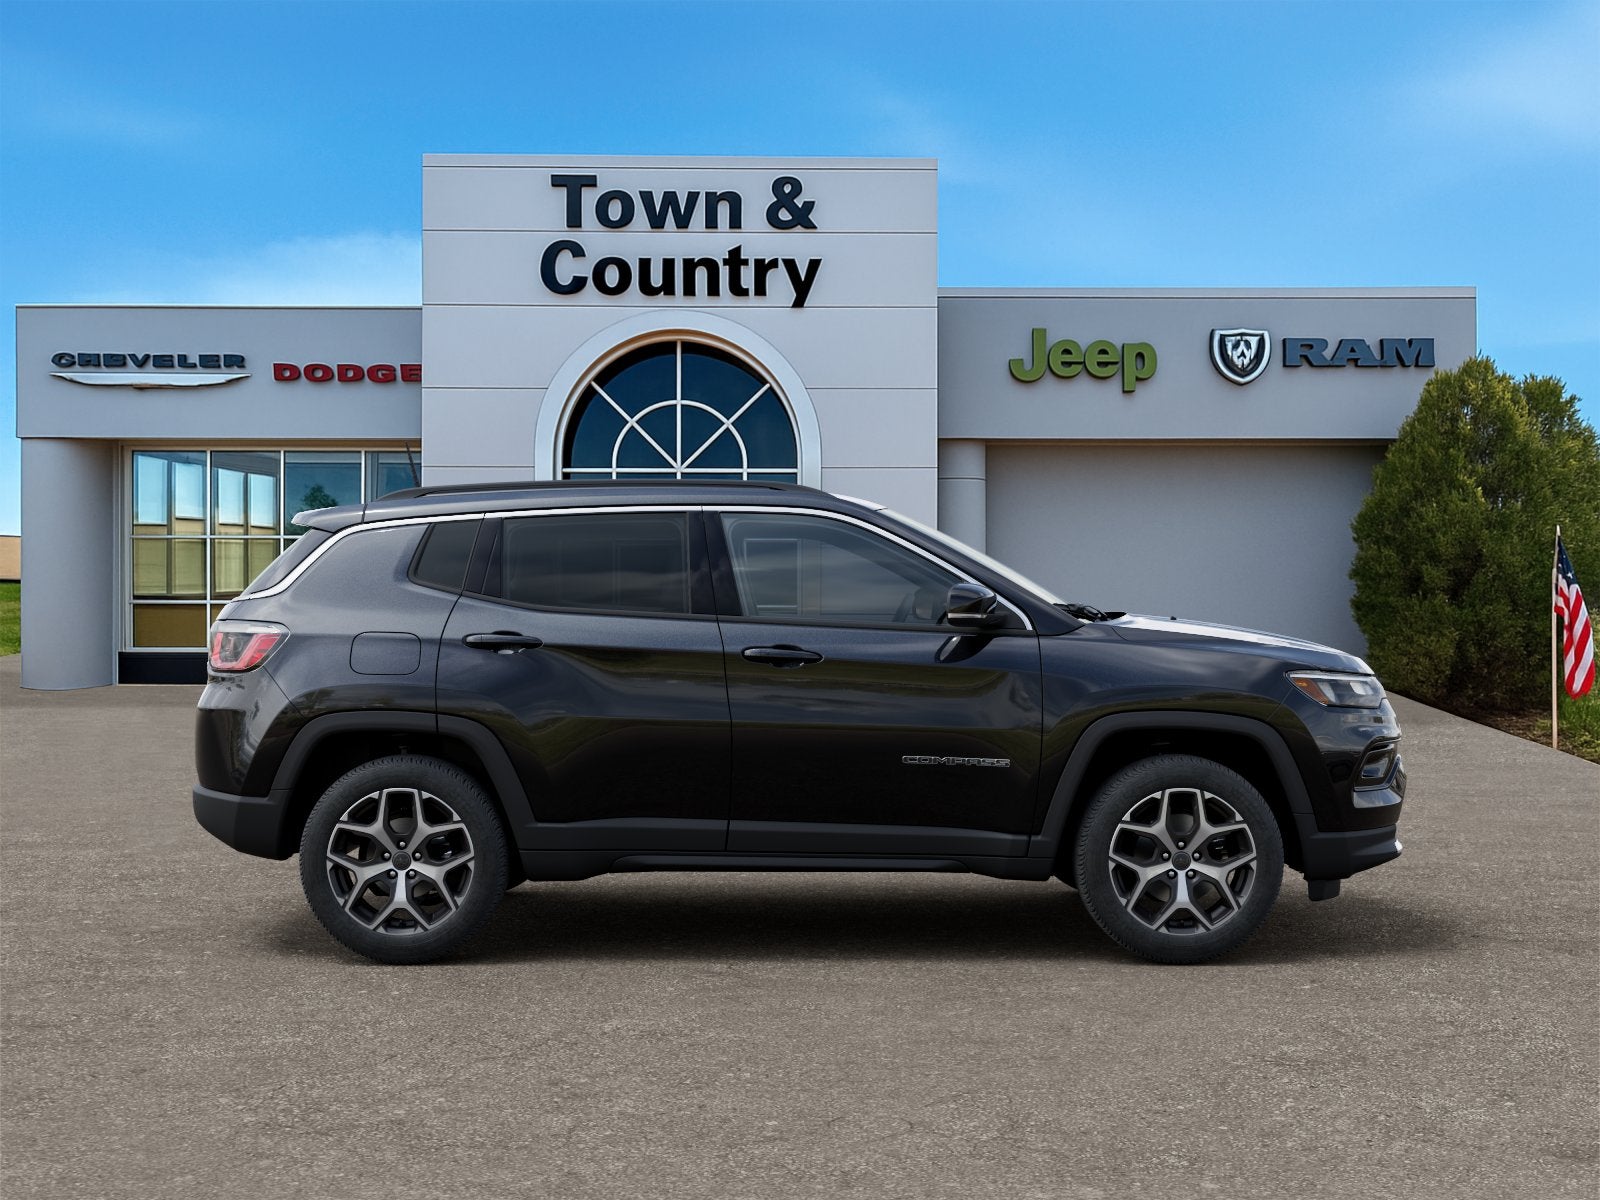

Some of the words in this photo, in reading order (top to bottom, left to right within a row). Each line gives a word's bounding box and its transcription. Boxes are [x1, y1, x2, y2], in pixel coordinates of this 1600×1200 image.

[550, 174, 743, 229] Town
[765, 176, 818, 229] &
[540, 239, 822, 308] Country
[1008, 328, 1157, 392] Jeep
[1282, 337, 1435, 368] RAM
[902, 756, 1011, 767] COMPASS
